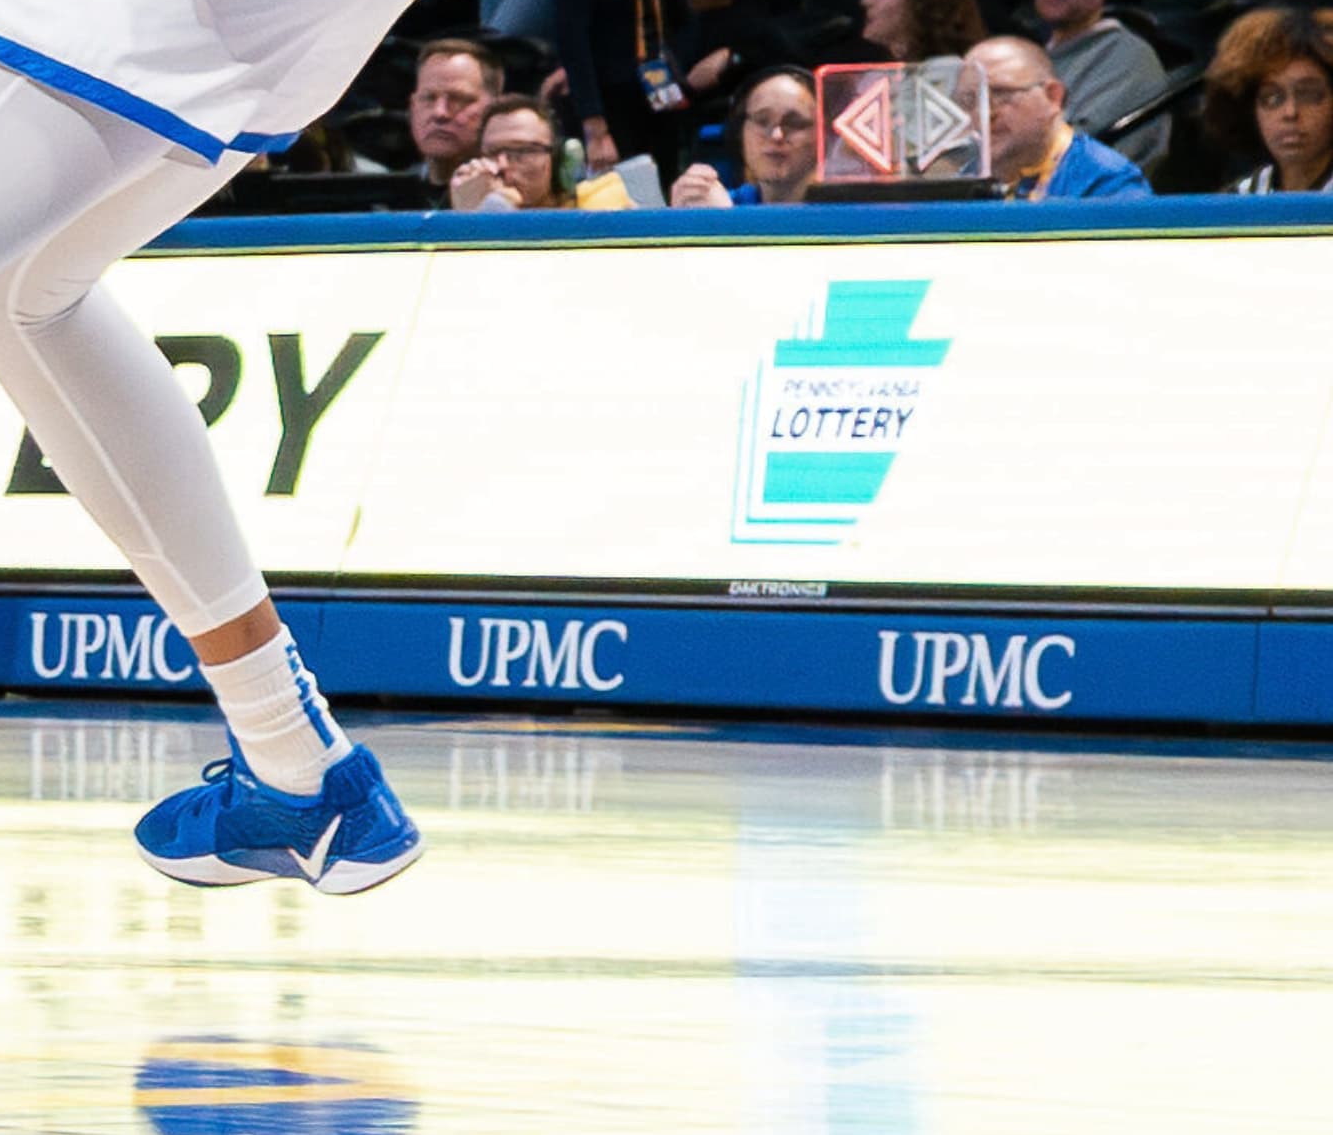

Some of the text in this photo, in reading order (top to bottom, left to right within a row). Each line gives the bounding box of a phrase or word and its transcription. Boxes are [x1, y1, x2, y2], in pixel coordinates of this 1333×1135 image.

[770, 406, 914, 439] LOTTERY
[30, 612, 193, 681] UPMC
[449, 617, 628, 692] UPMC
[877, 629, 1076, 710] UPMC
